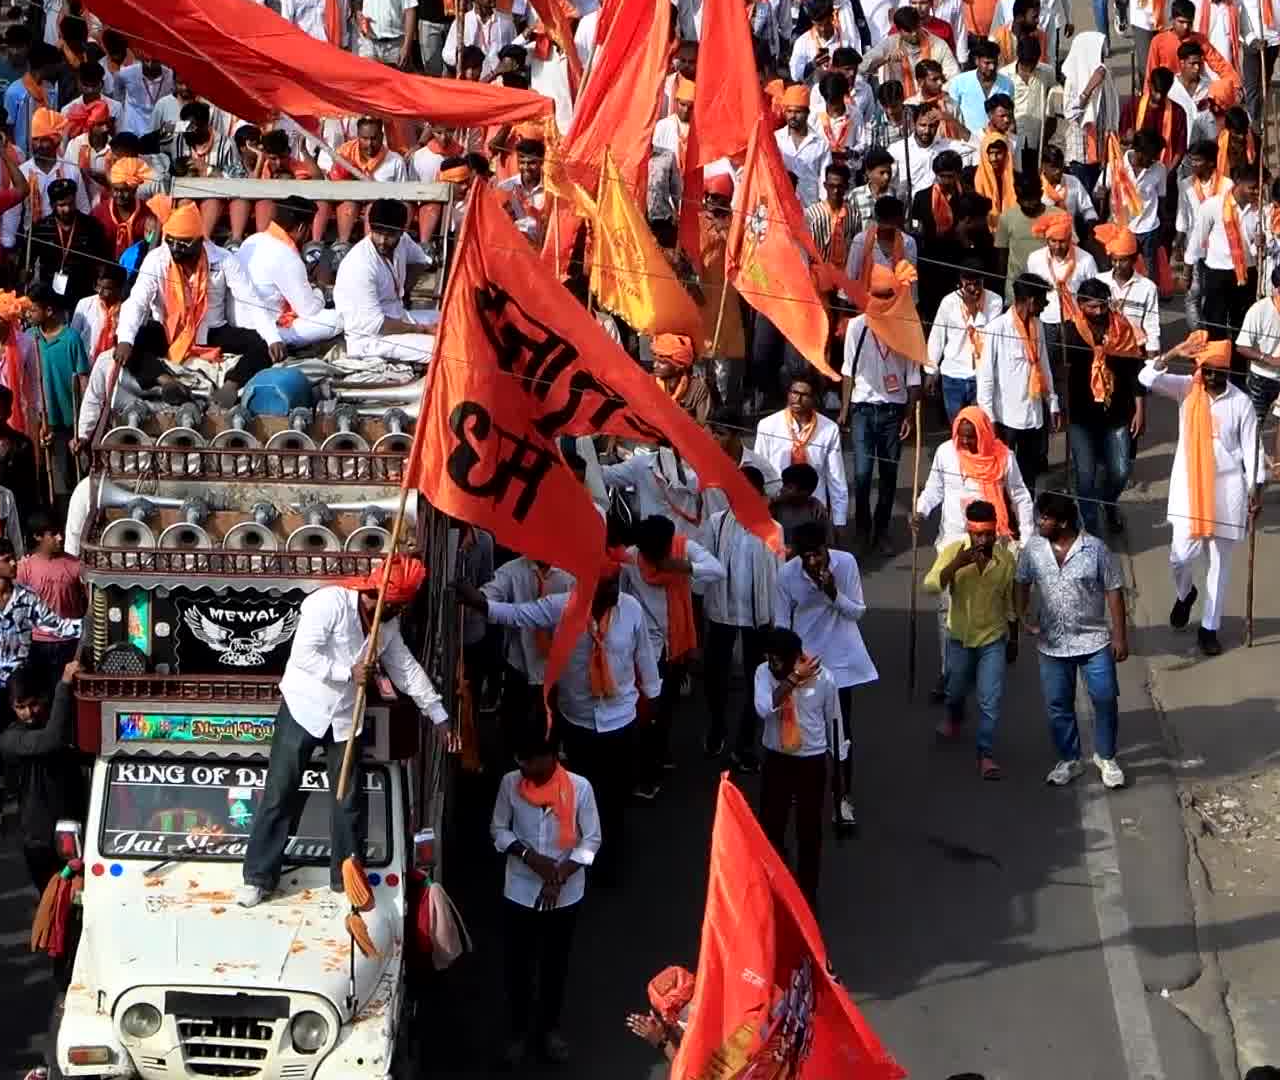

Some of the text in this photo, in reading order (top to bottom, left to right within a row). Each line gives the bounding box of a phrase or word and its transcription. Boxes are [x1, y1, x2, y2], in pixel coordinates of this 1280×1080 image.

[209, 606, 280, 624] MEWAL
[116, 762, 186, 785] KING
[191, 766, 232, 786] OF
[114, 831, 166, 855] Jai
